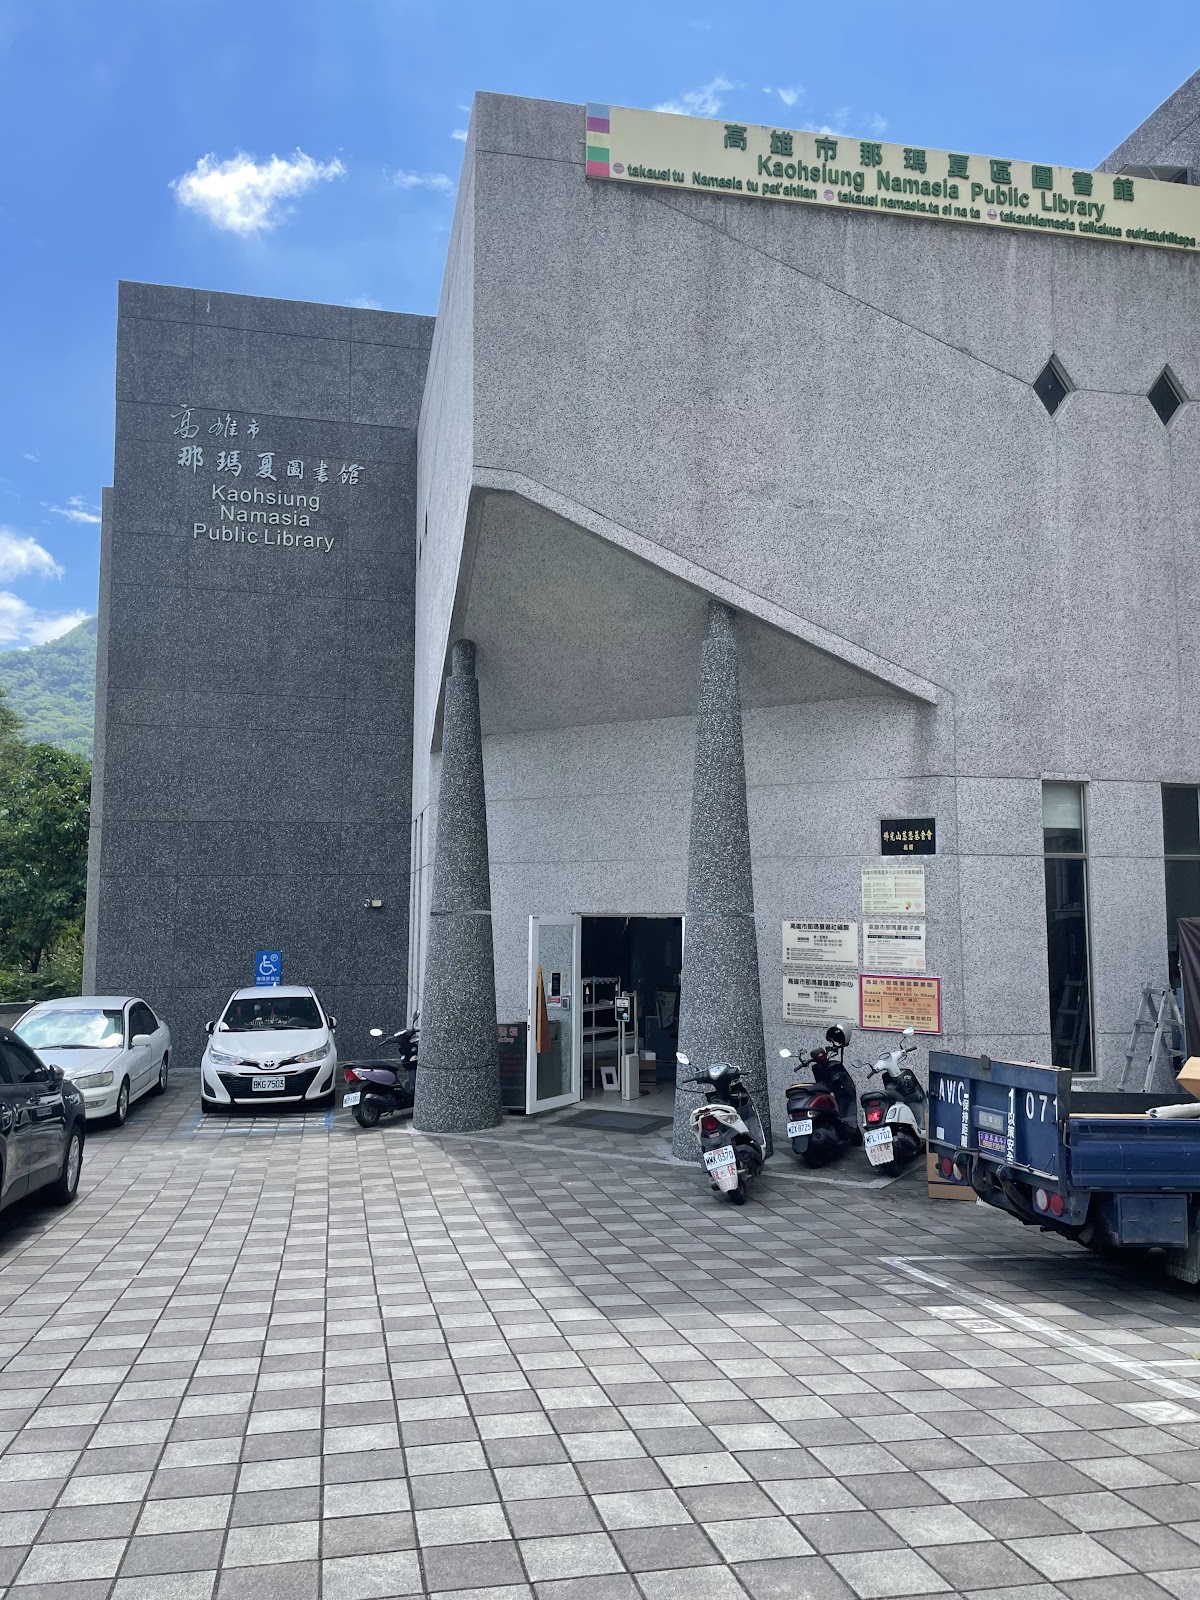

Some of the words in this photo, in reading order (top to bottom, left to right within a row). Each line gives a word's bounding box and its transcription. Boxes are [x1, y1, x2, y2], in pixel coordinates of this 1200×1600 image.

[627, 163, 671, 182] takausi
[672, 170, 685, 183] tu
[692, 171, 742, 190] Namasia
[746, 179, 758, 193] tu
[723, 123, 1135, 202] 高雄市那瑪夏區圖書館
[757, 154, 865, 192] Kaohsiung
[877, 169, 959, 200] Namasia
[971, 182, 1030, 208] Public
[1040, 191, 1105, 222] Library
[837, 190, 878, 207] takausi
[170, 404, 260, 440] 高雄市
[177, 444, 366, 486] 那瑪夏圖書館
[211, 483, 321, 512] Kaohsiung
[220, 504, 311, 527] Namasia
[193, 522, 259, 544] Public
[264, 528, 335, 553] Library
